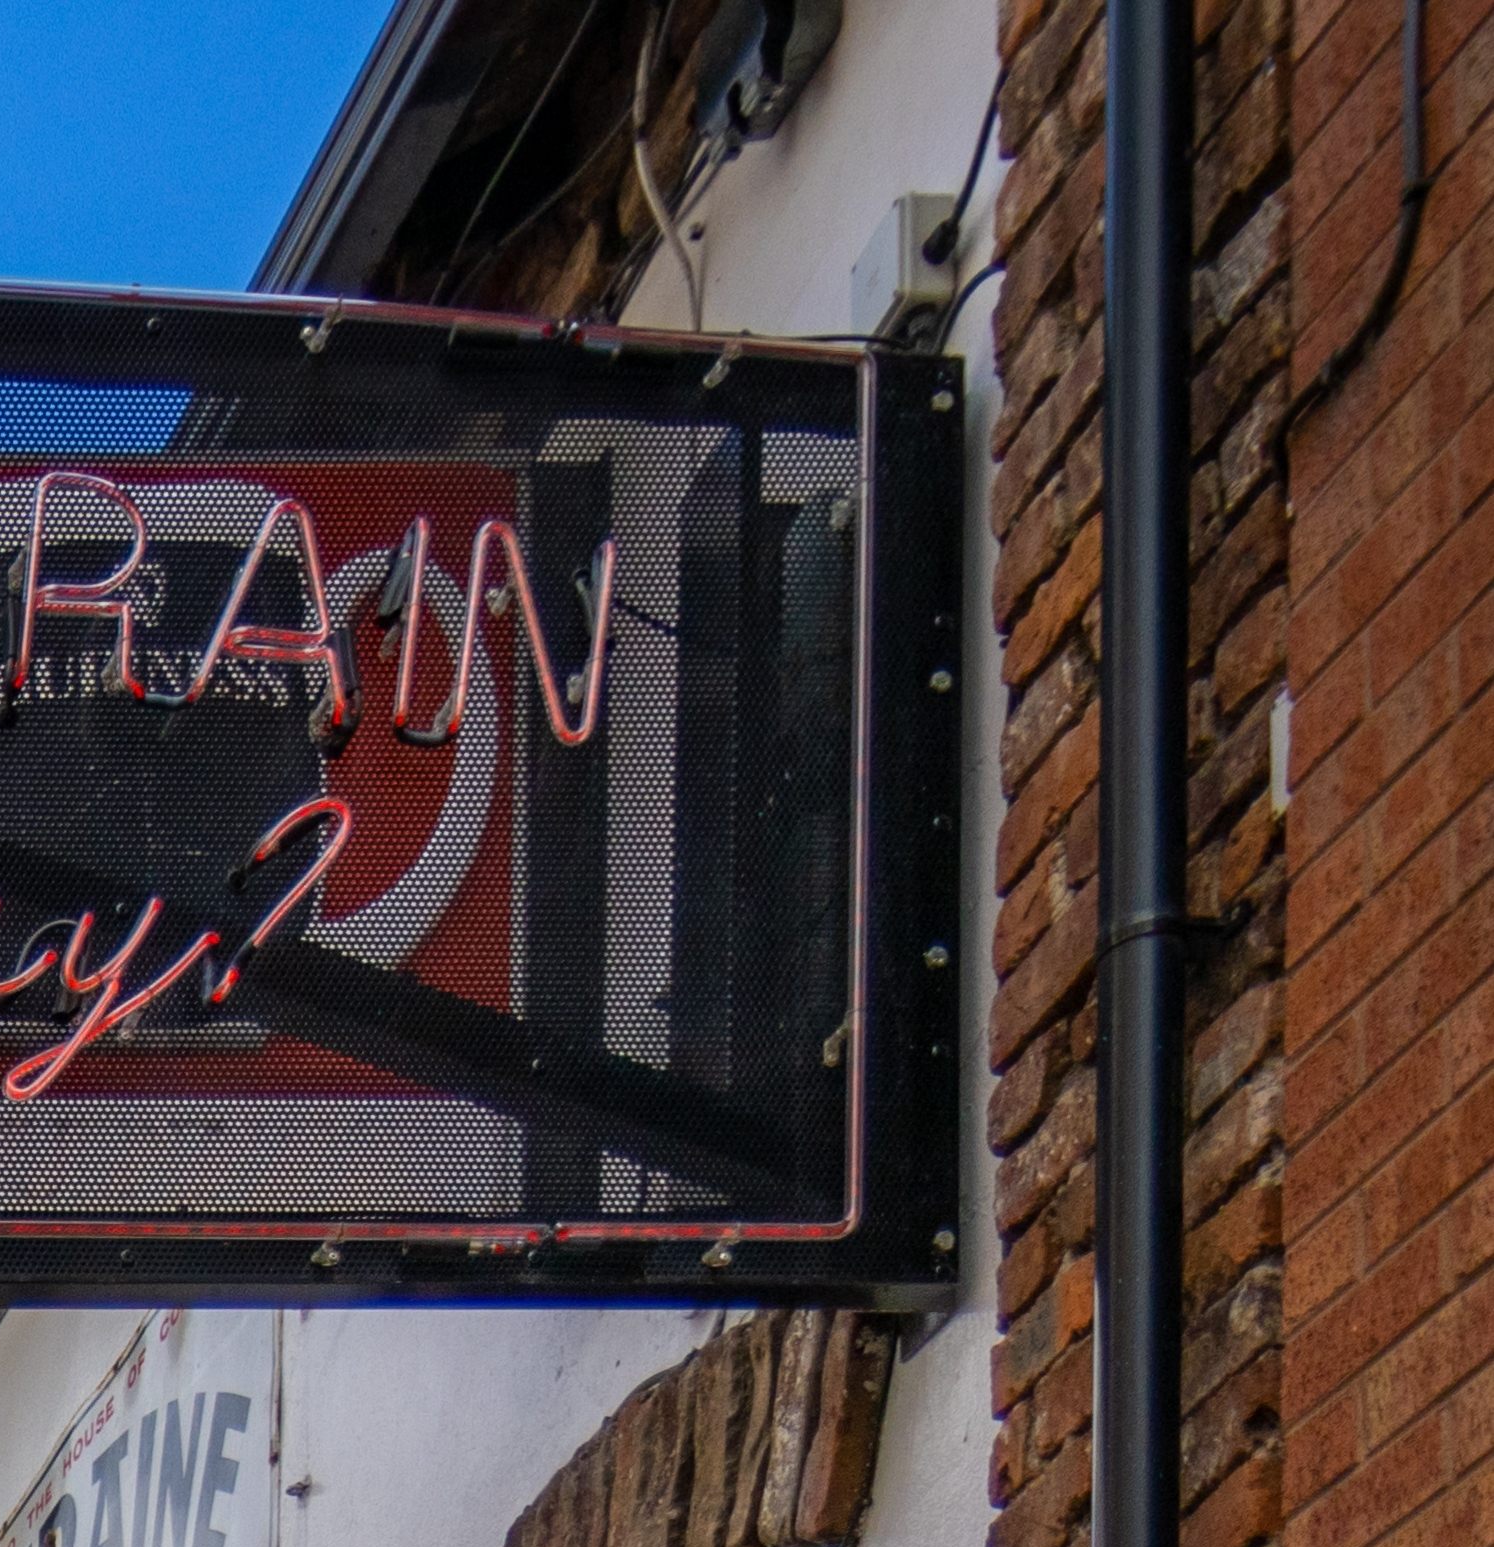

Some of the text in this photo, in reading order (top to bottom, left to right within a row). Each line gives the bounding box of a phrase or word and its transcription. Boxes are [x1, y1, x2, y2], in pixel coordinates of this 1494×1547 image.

[10, 470, 616, 746] RAIN
[25, 1481, 55, 1531] THE
[61, 1400, 116, 1475] HOUSE
[126, 1356, 147, 1393] OF
